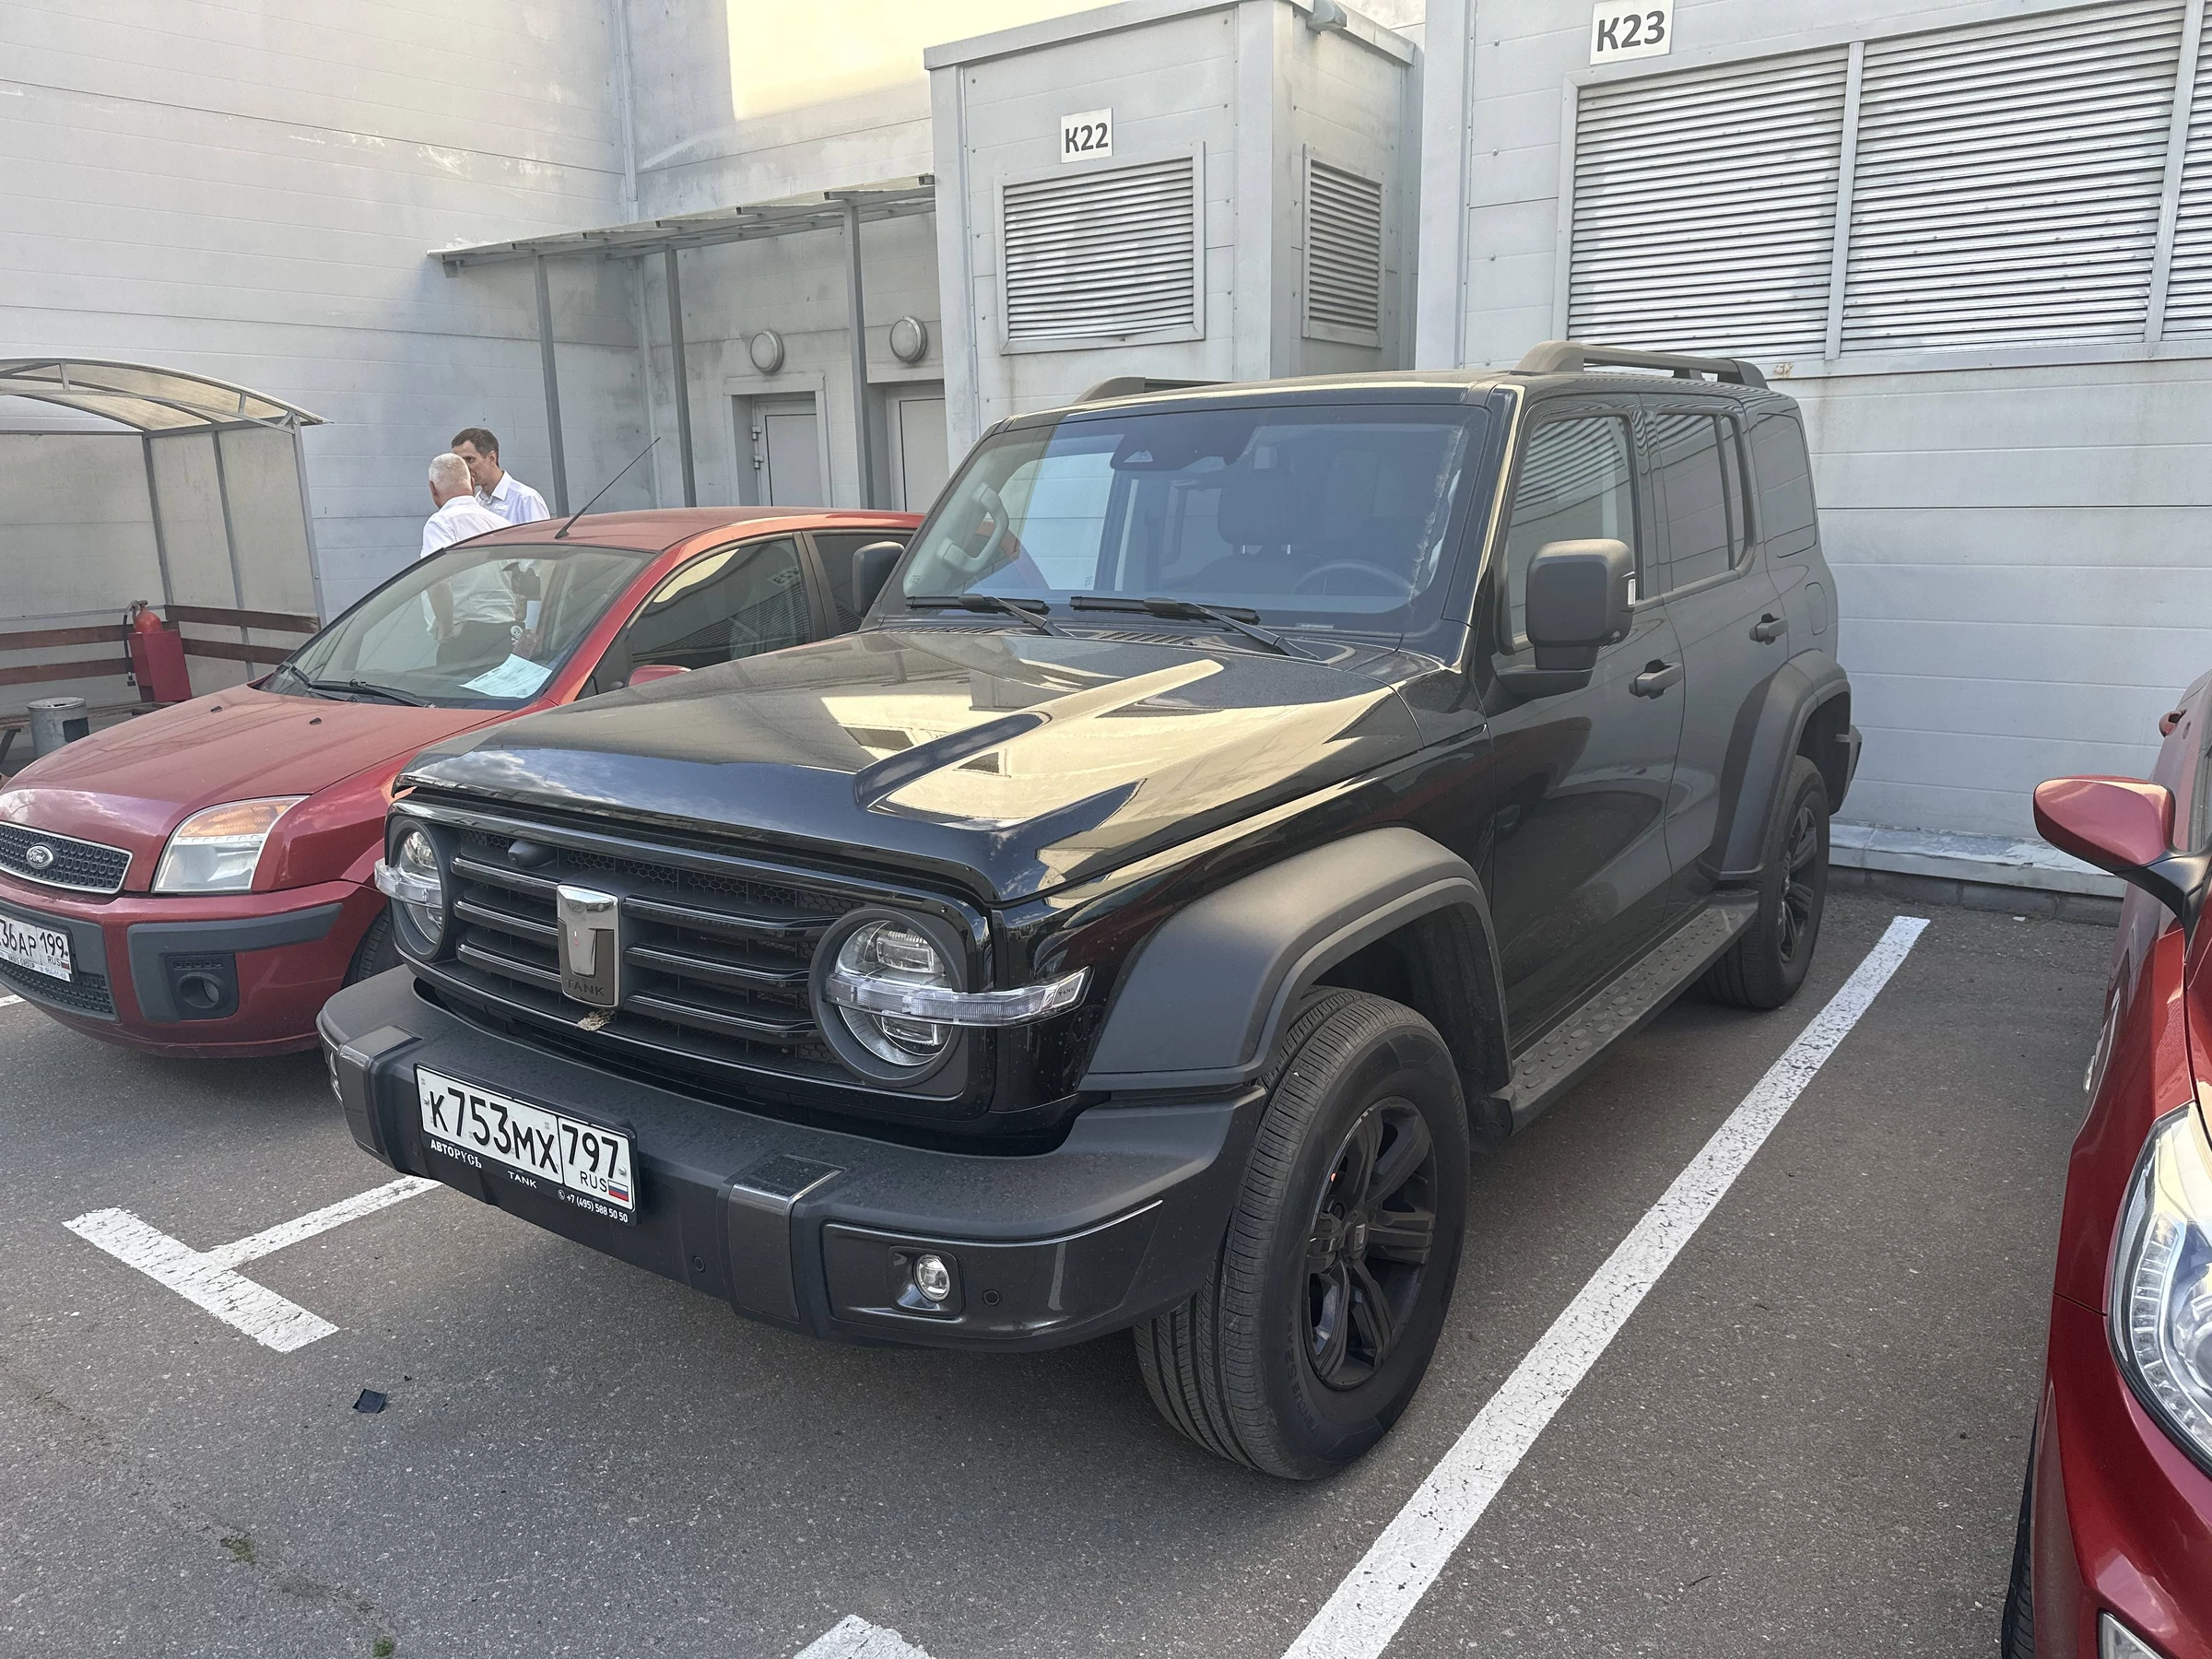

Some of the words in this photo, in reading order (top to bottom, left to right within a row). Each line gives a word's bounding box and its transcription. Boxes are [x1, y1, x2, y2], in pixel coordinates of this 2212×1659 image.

[1596, 10, 1665, 52] К23
[1065, 122, 1109, 154] К22
[0, 918, 37, 958] 36АР
[40, 932, 65, 959] 199
[47, 955, 61, 967] RUS
[565, 977, 605, 997] TANK
[1058, 987, 1076, 996] TANK
[429, 1087, 559, 1174] К753МХ
[562, 1124, 618, 1179] 797
[430, 1138, 482, 1169] АВТОРУСЬ
[507, 1171, 537, 1189] TANK
[580, 1170, 607, 1193] RUS
[567, 1194, 575, 1204] +7
[576, 1196, 594, 1212] (495)
[594, 1203, 608, 1216] 588
[608, 1208, 618, 1219] 50
[618, 1212, 629, 1223] 50
